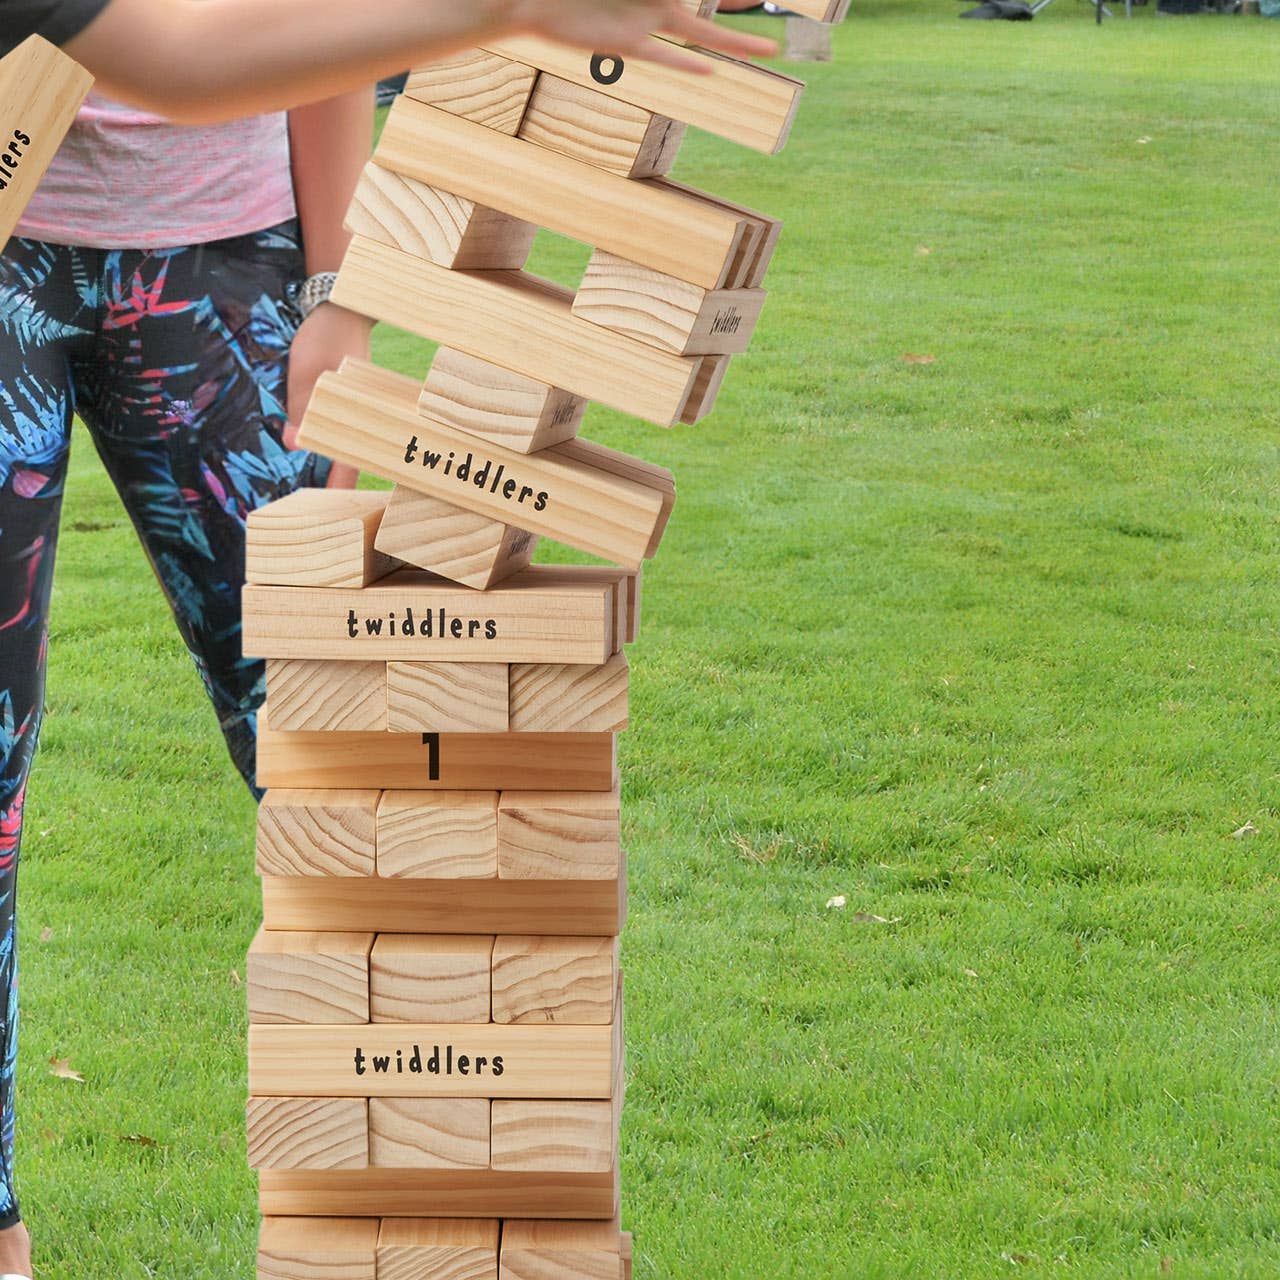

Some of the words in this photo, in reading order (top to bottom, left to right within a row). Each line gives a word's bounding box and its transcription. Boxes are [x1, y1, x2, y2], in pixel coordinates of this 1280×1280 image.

[403, 435, 549, 512] twiddlers
[347, 607, 498, 640] twiddlers
[422, 732, 440, 781] 1
[354, 1044, 505, 1077] twiddlers
